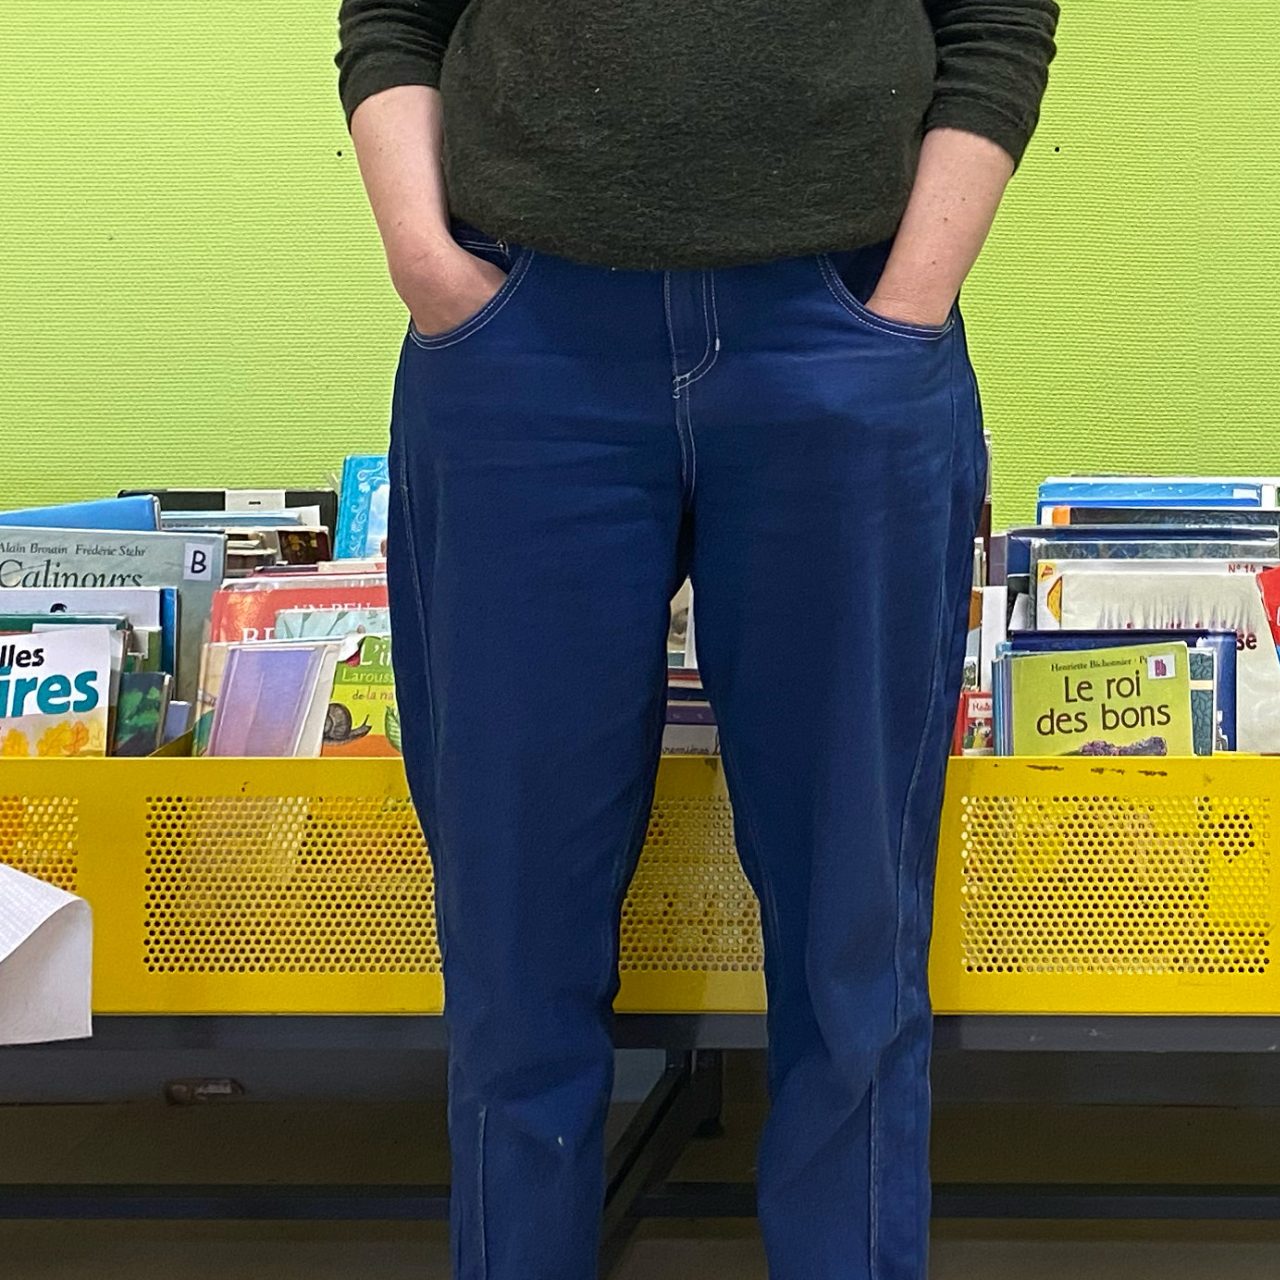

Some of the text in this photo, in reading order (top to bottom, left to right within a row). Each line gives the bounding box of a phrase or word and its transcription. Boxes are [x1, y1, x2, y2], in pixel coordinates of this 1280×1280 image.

[190, 550, 207, 573] B
[366, 686, 378, 700] la
[1064, 670, 1141, 703] Le roi
[1036, 703, 1171, 736] des bons
